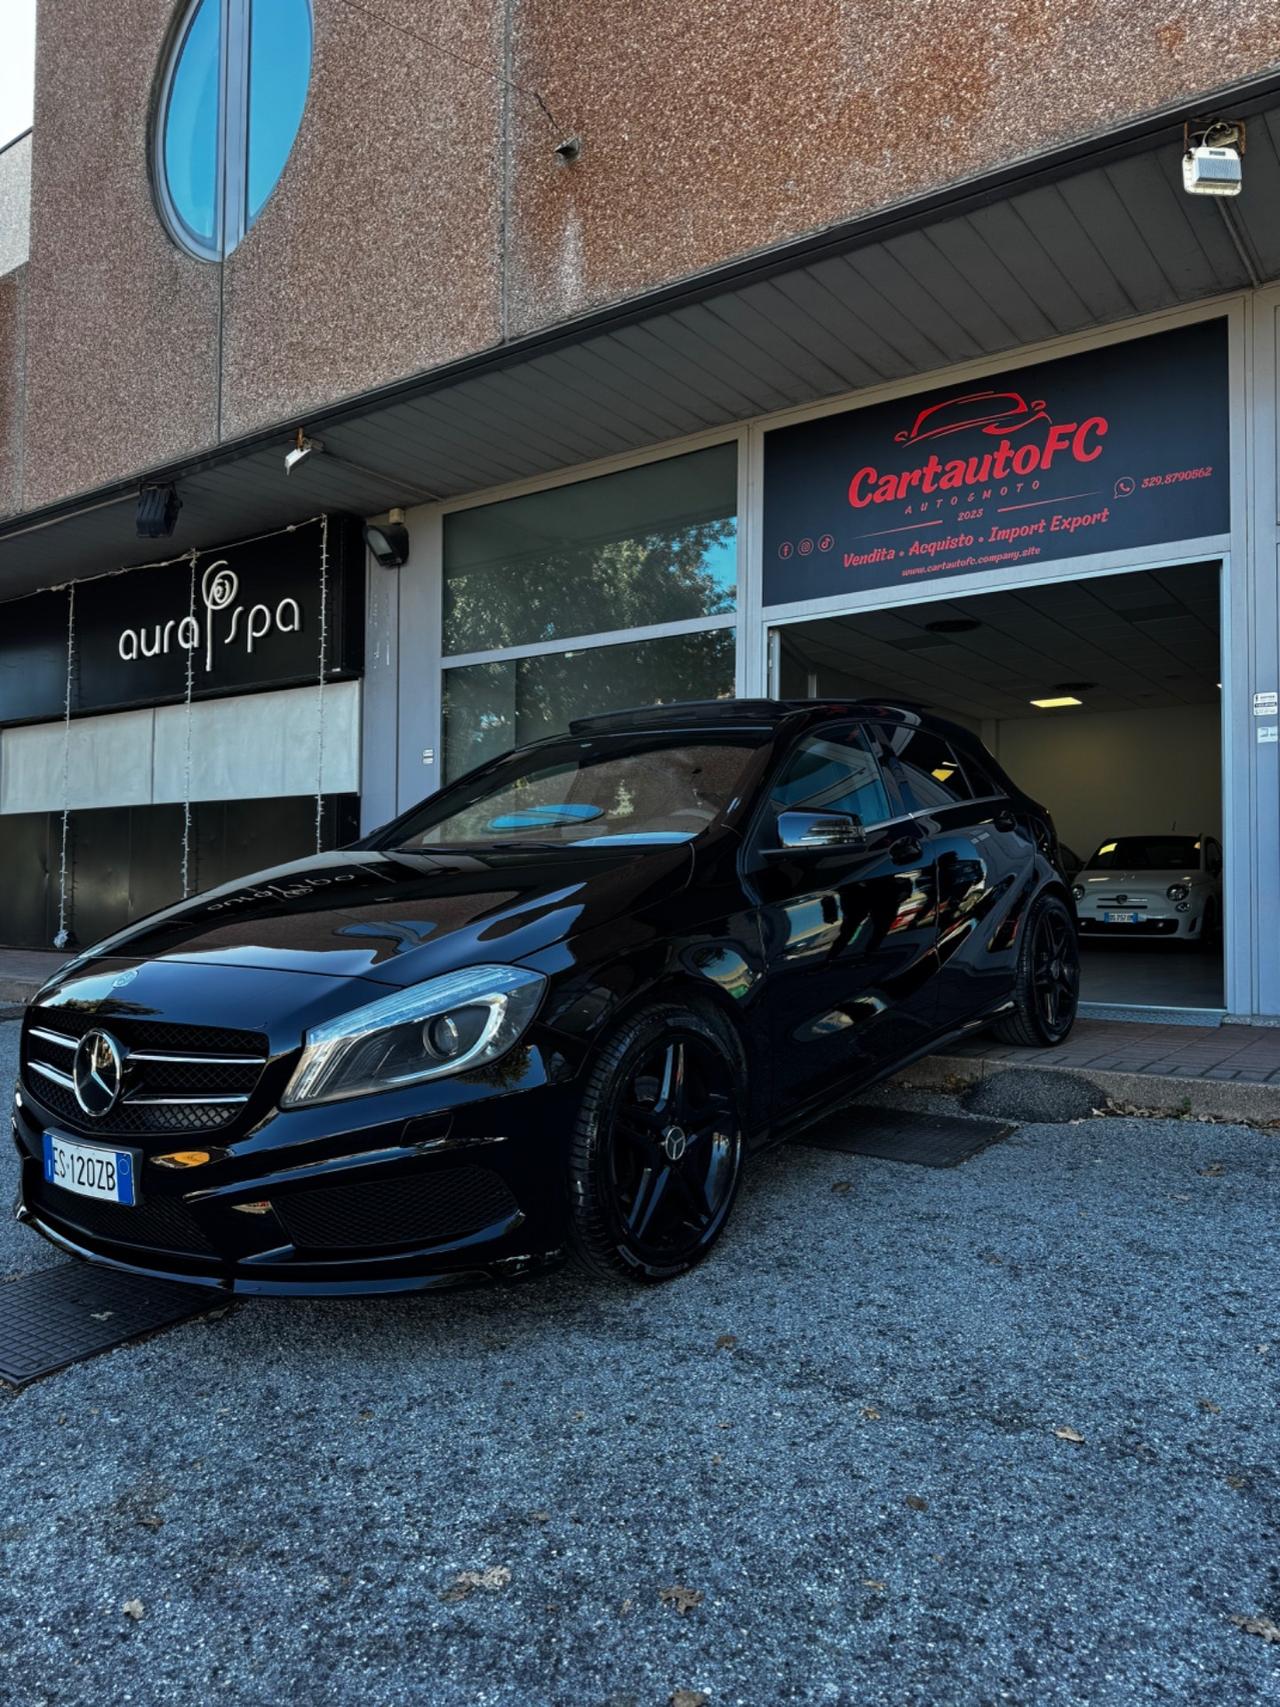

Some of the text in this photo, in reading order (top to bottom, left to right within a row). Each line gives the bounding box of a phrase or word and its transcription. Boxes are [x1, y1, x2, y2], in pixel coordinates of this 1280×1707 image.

[848, 416, 1108, 508] CartautoFC
[843, 508, 1110, 568] Vendita Acquisto Import Export
[901, 547, 1041, 577] www.cartautofc.company.site
[118, 598, 300, 660] aura spa
